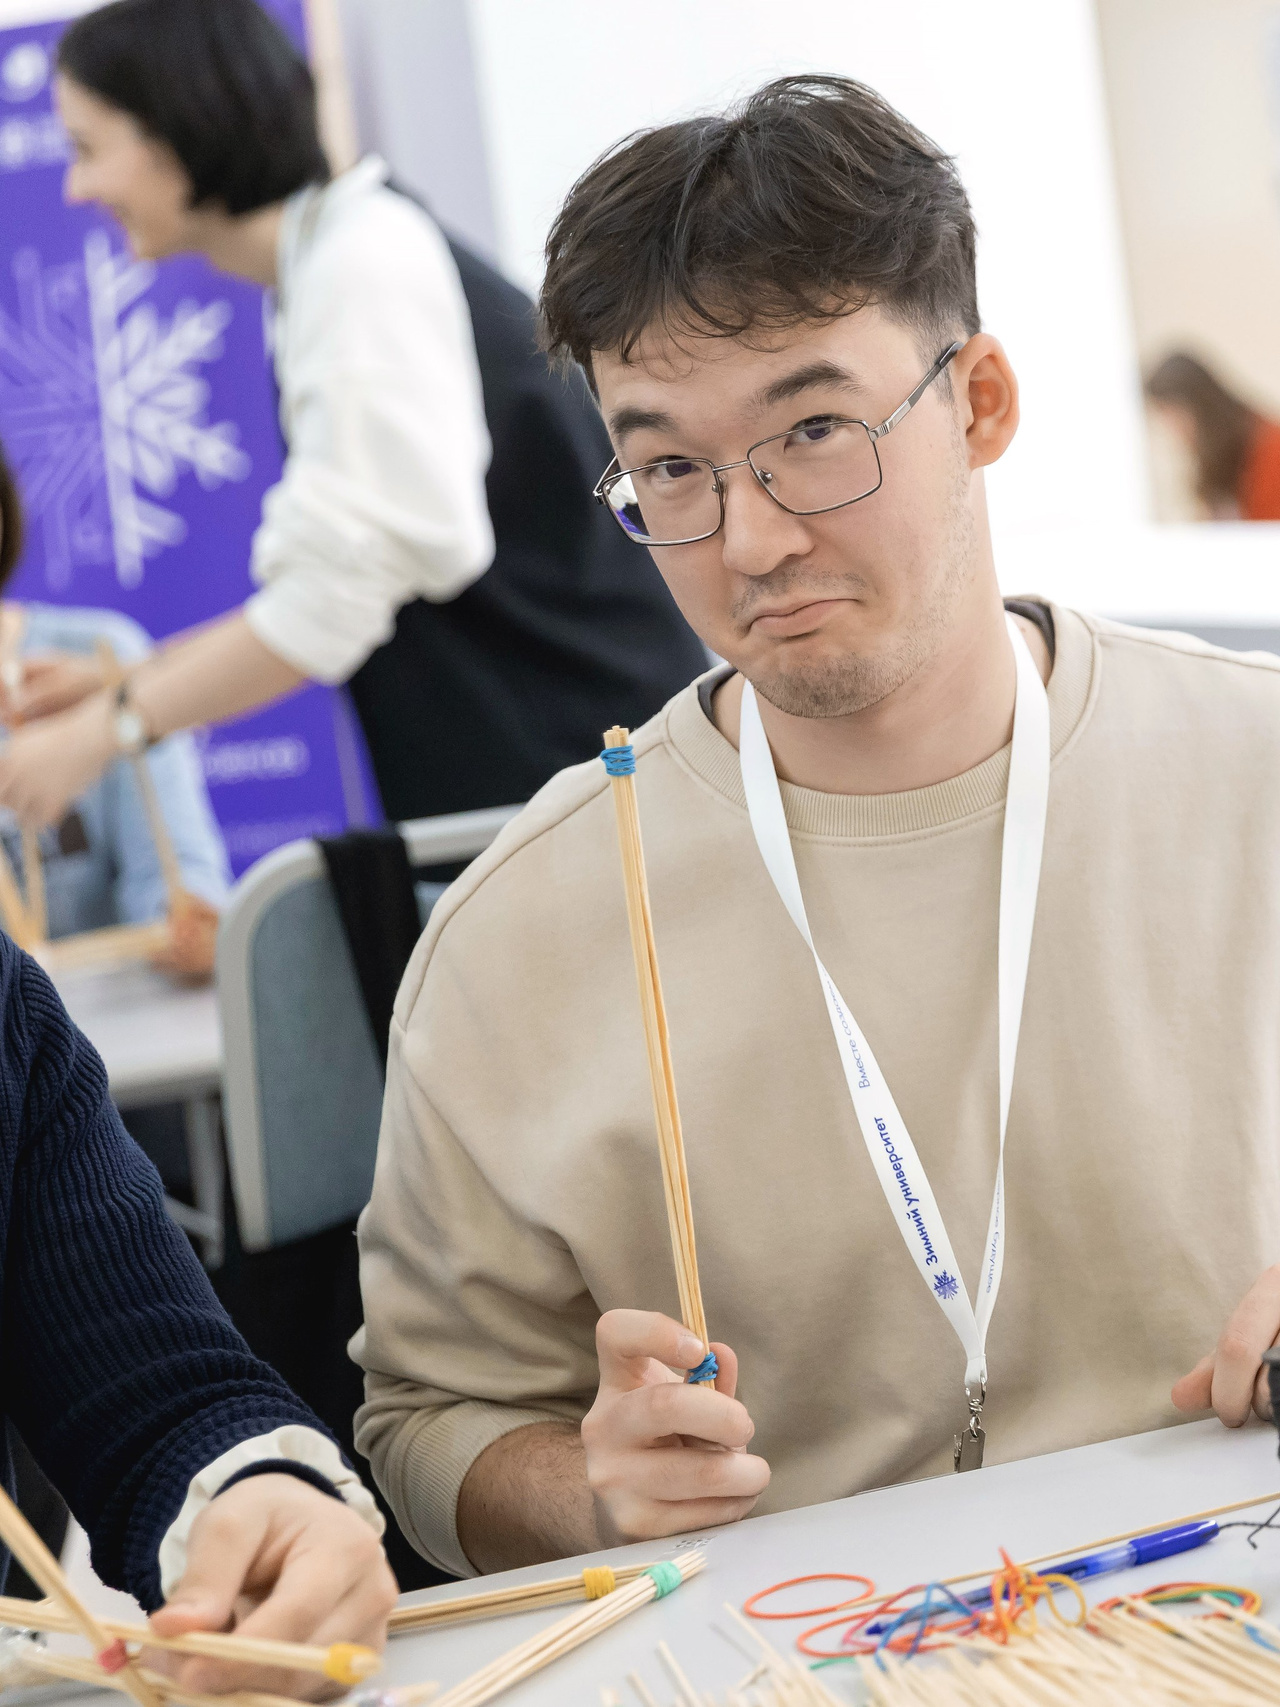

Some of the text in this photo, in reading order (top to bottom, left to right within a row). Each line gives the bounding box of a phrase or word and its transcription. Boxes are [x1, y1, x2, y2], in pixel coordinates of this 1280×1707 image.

[848, 1038, 871, 1089] Вместе
[873, 1115, 938, 1266] Зимний университет
